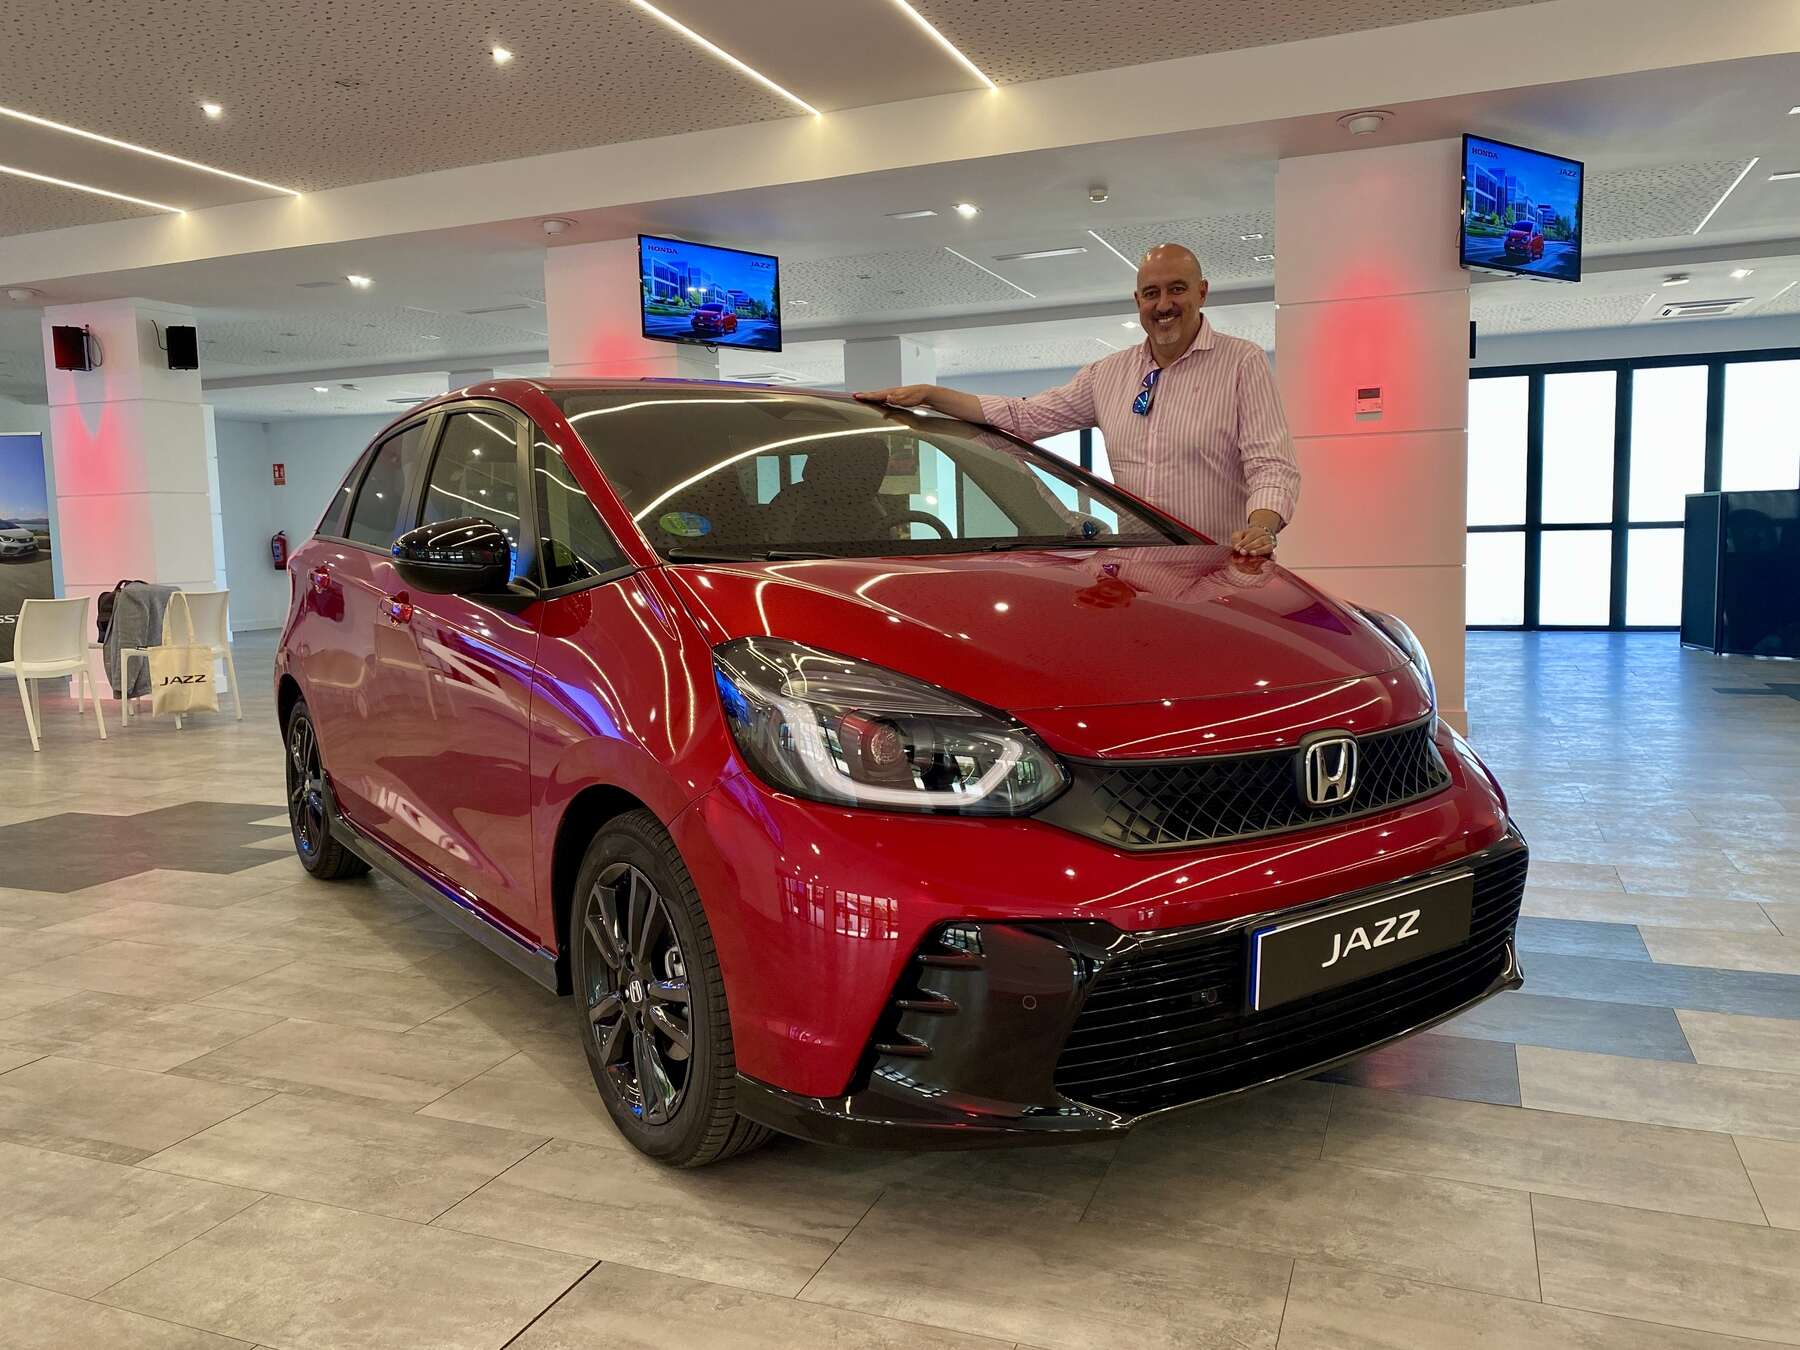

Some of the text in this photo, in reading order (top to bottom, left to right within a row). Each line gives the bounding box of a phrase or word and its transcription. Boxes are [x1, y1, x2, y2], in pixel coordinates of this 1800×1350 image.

[1472, 147, 1498, 159] HONDA
[648, 244, 678, 255] HONDA
[160, 674, 207, 687] JAZZ
[1321, 909, 1422, 968] JAZZ
